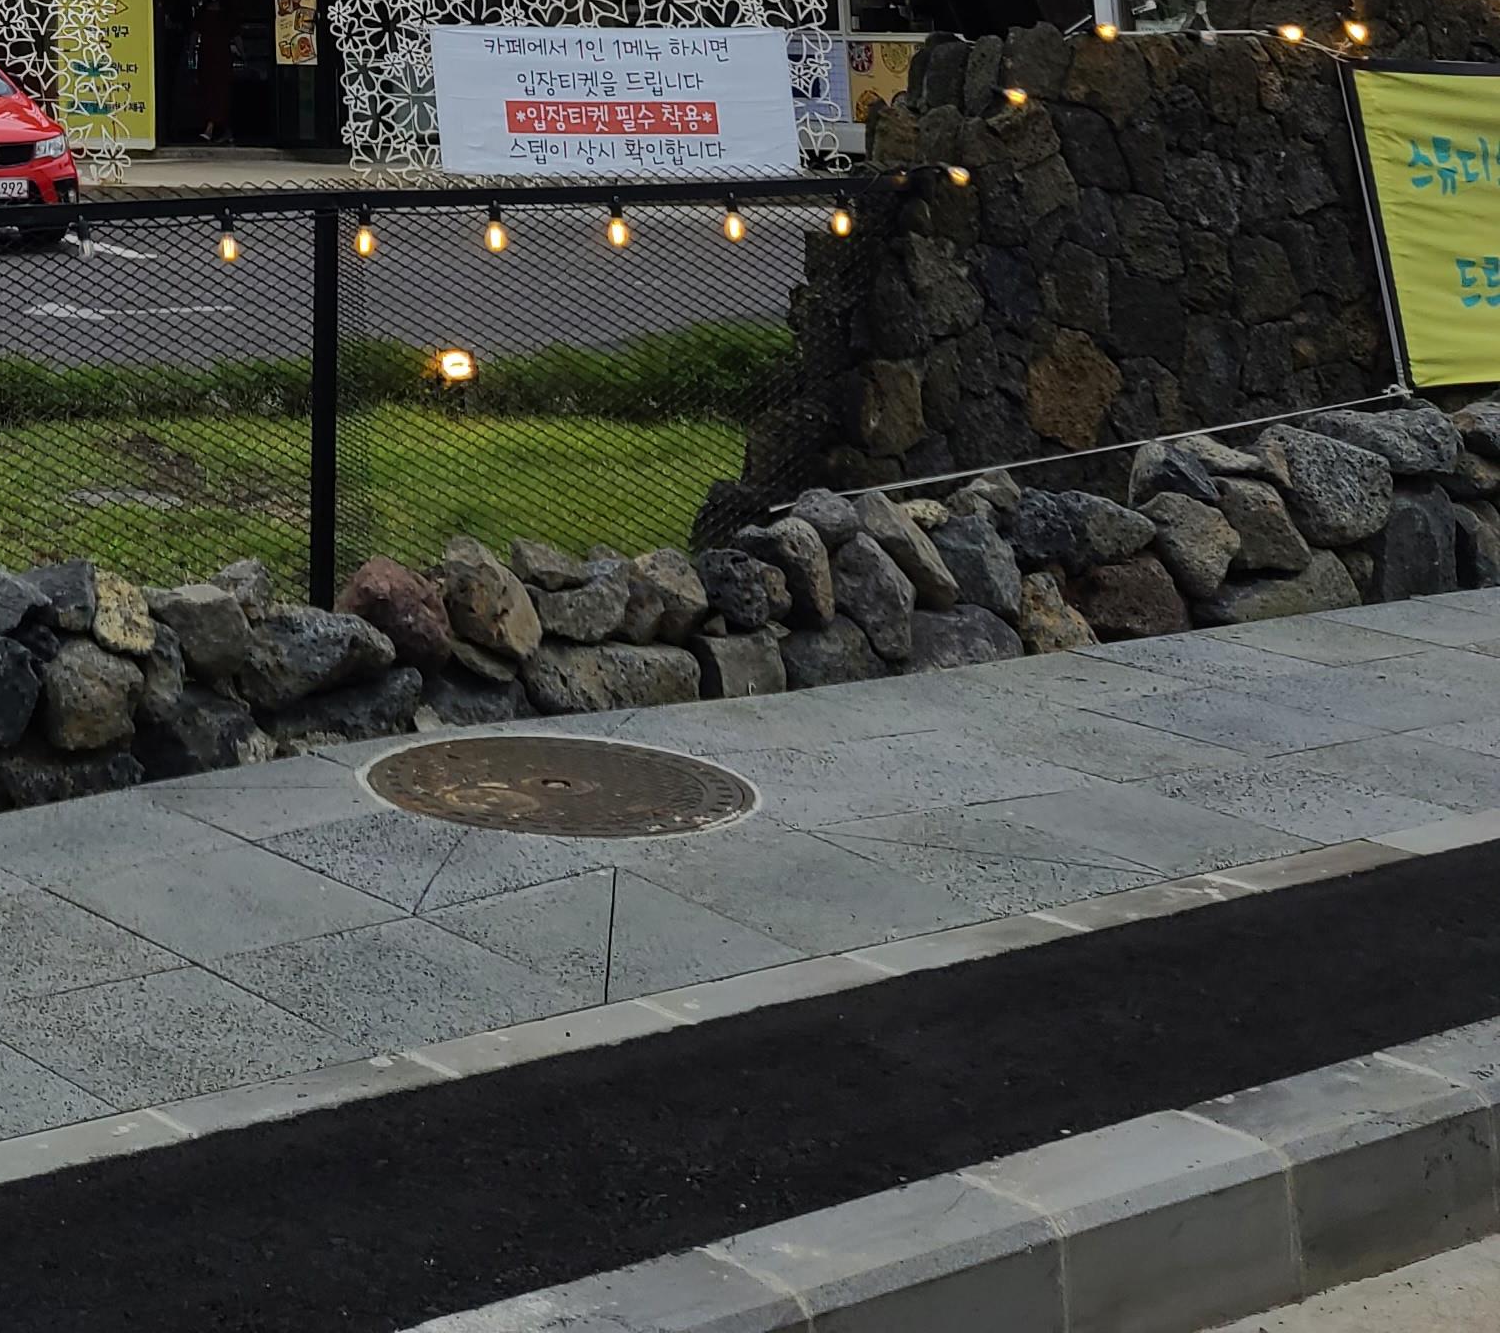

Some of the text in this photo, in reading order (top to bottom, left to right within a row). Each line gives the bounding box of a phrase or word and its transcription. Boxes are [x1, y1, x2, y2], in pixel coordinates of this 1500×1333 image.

[484, 37, 729, 62] 카페에서 1인 1메뉴 하시면
[517, 70, 704, 97] 입장티켓을 드립니다
[616, 105, 655, 132] 필수
[510, 138, 727, 166] 스텝이 상시 확인합니다
[1408, 136, 1500, 195] 스튜디
